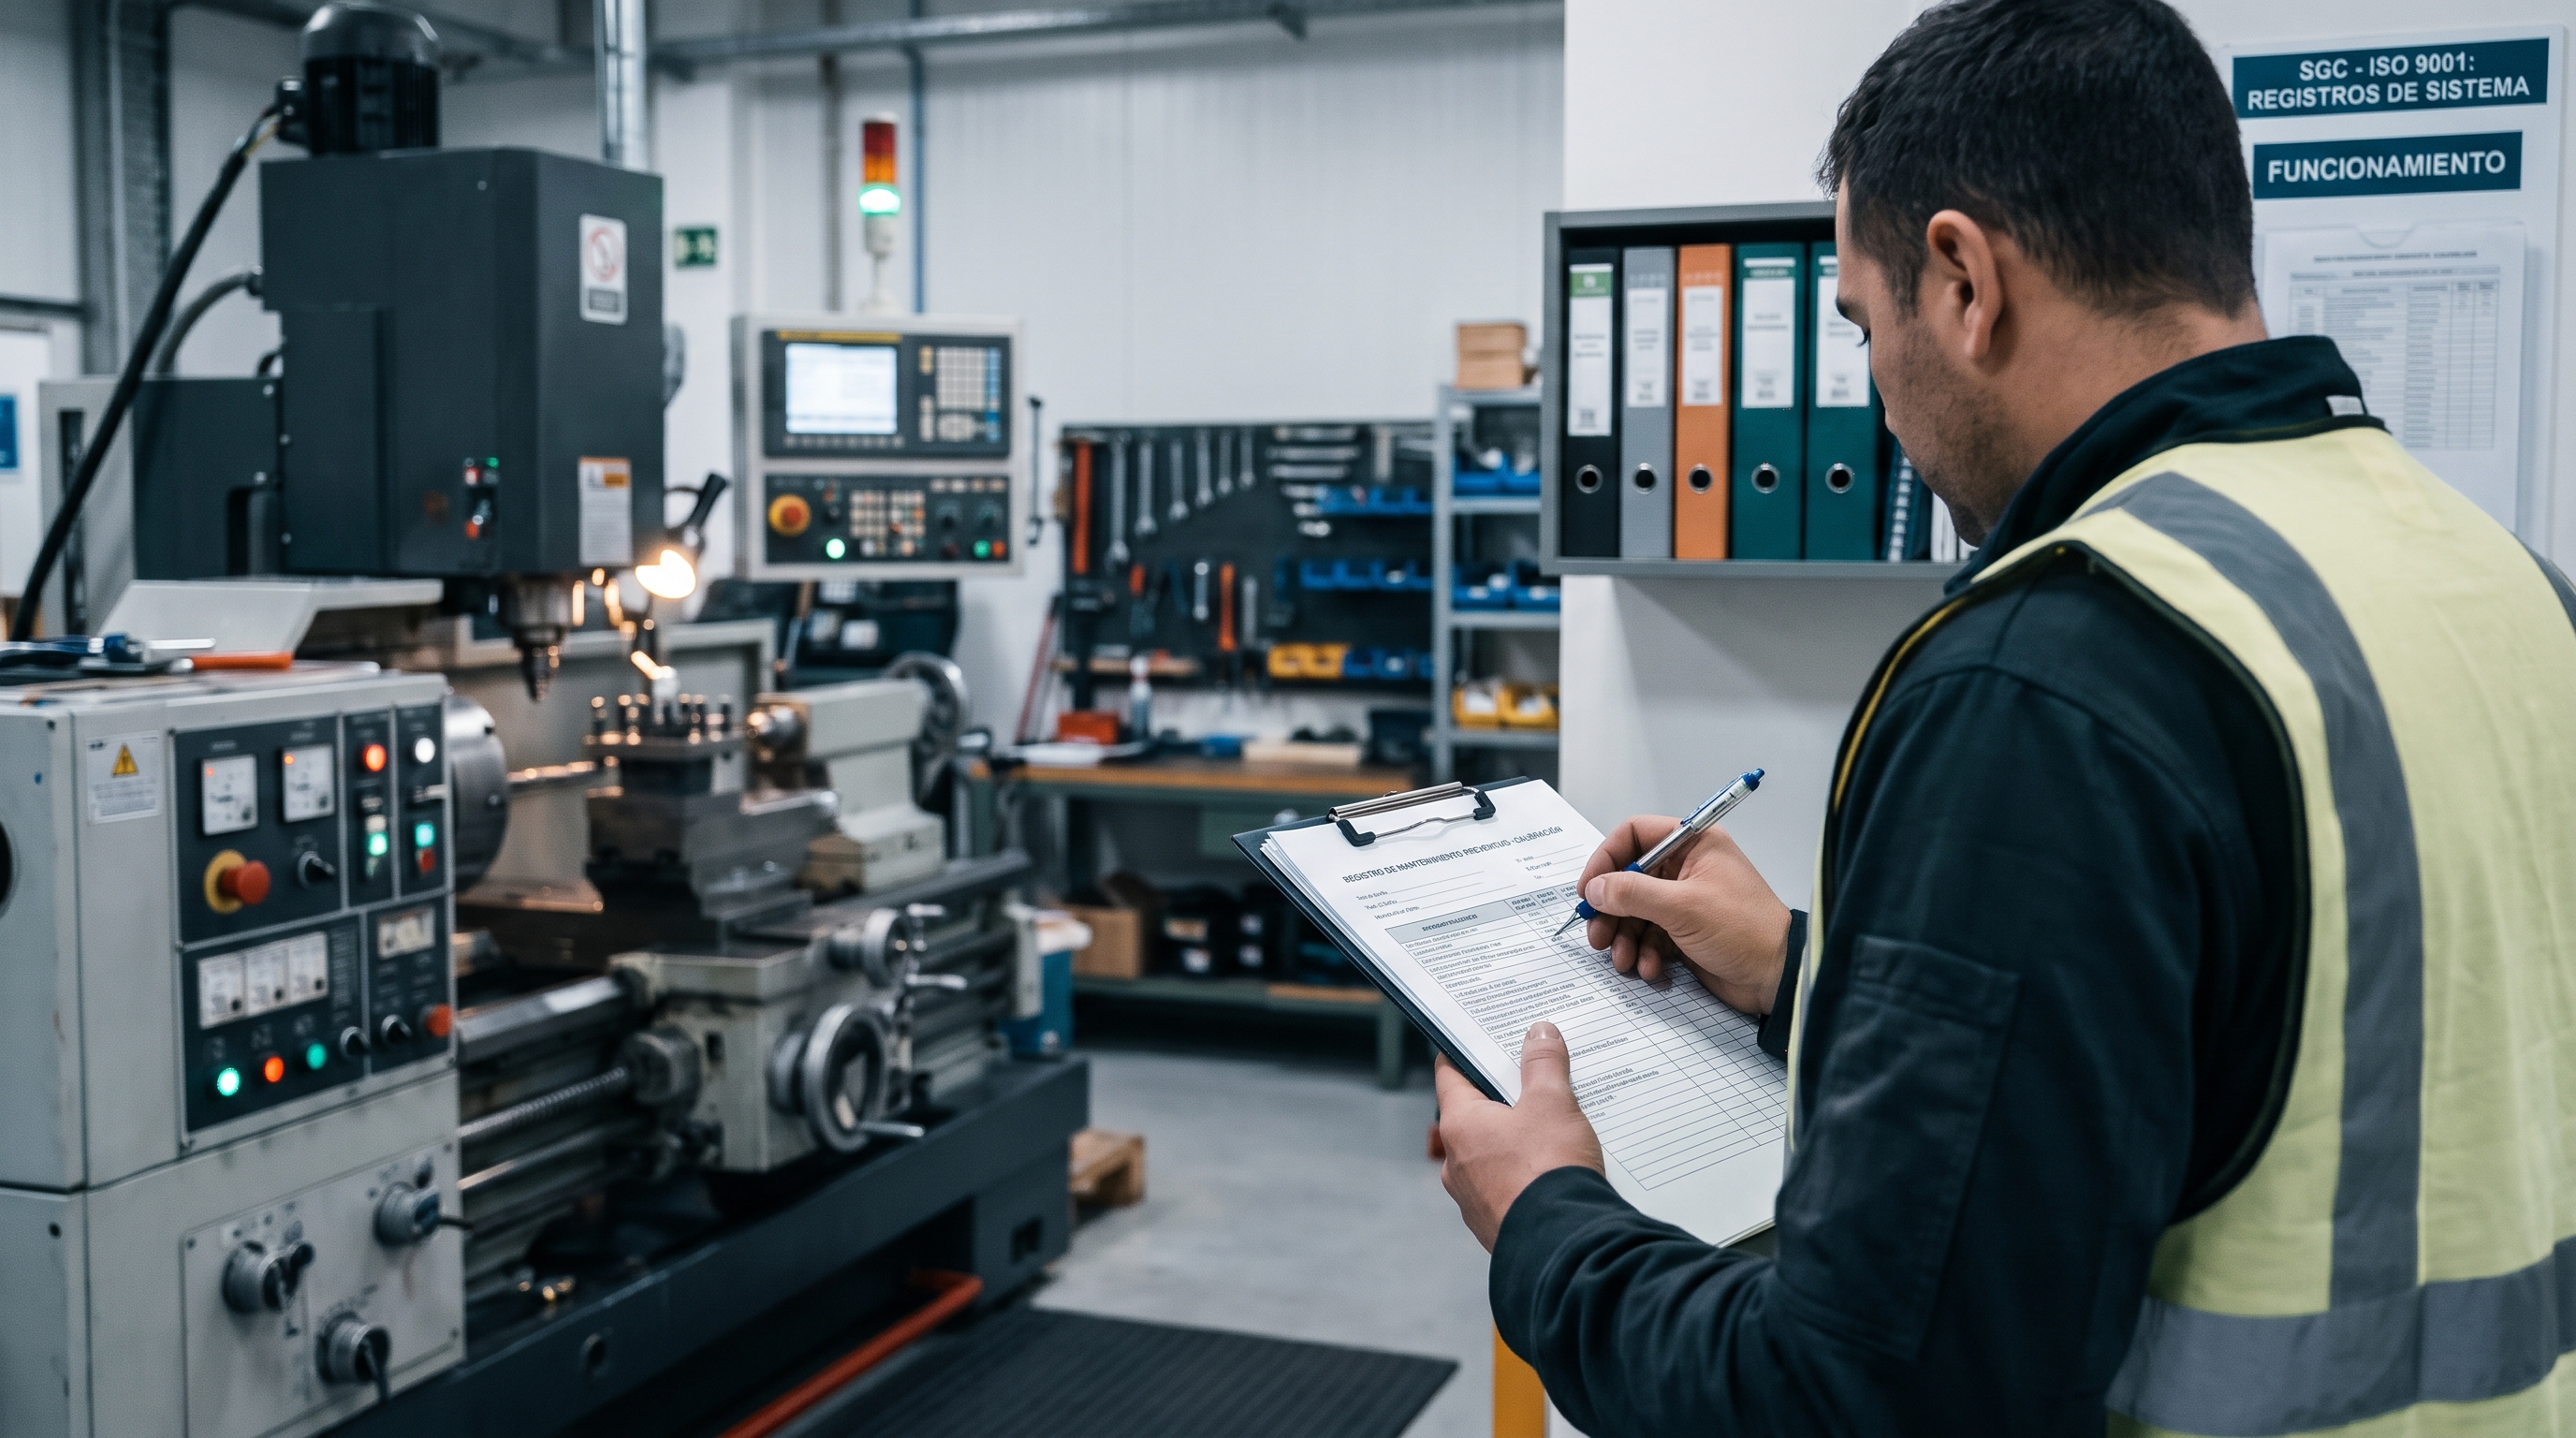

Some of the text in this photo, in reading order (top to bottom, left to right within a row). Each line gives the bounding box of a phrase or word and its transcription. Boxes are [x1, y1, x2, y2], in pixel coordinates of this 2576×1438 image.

[2299, 58, 2349, 81] SGC
[2369, 54, 2409, 78] ISO
[2415, 51, 2475, 75] 9001:
[2247, 75, 2530, 110] REGISTROS DE SISTEMA
[2268, 150, 2506, 183] FUNCIONAMIENTO
[1383, 865, 1398, 874] DE
